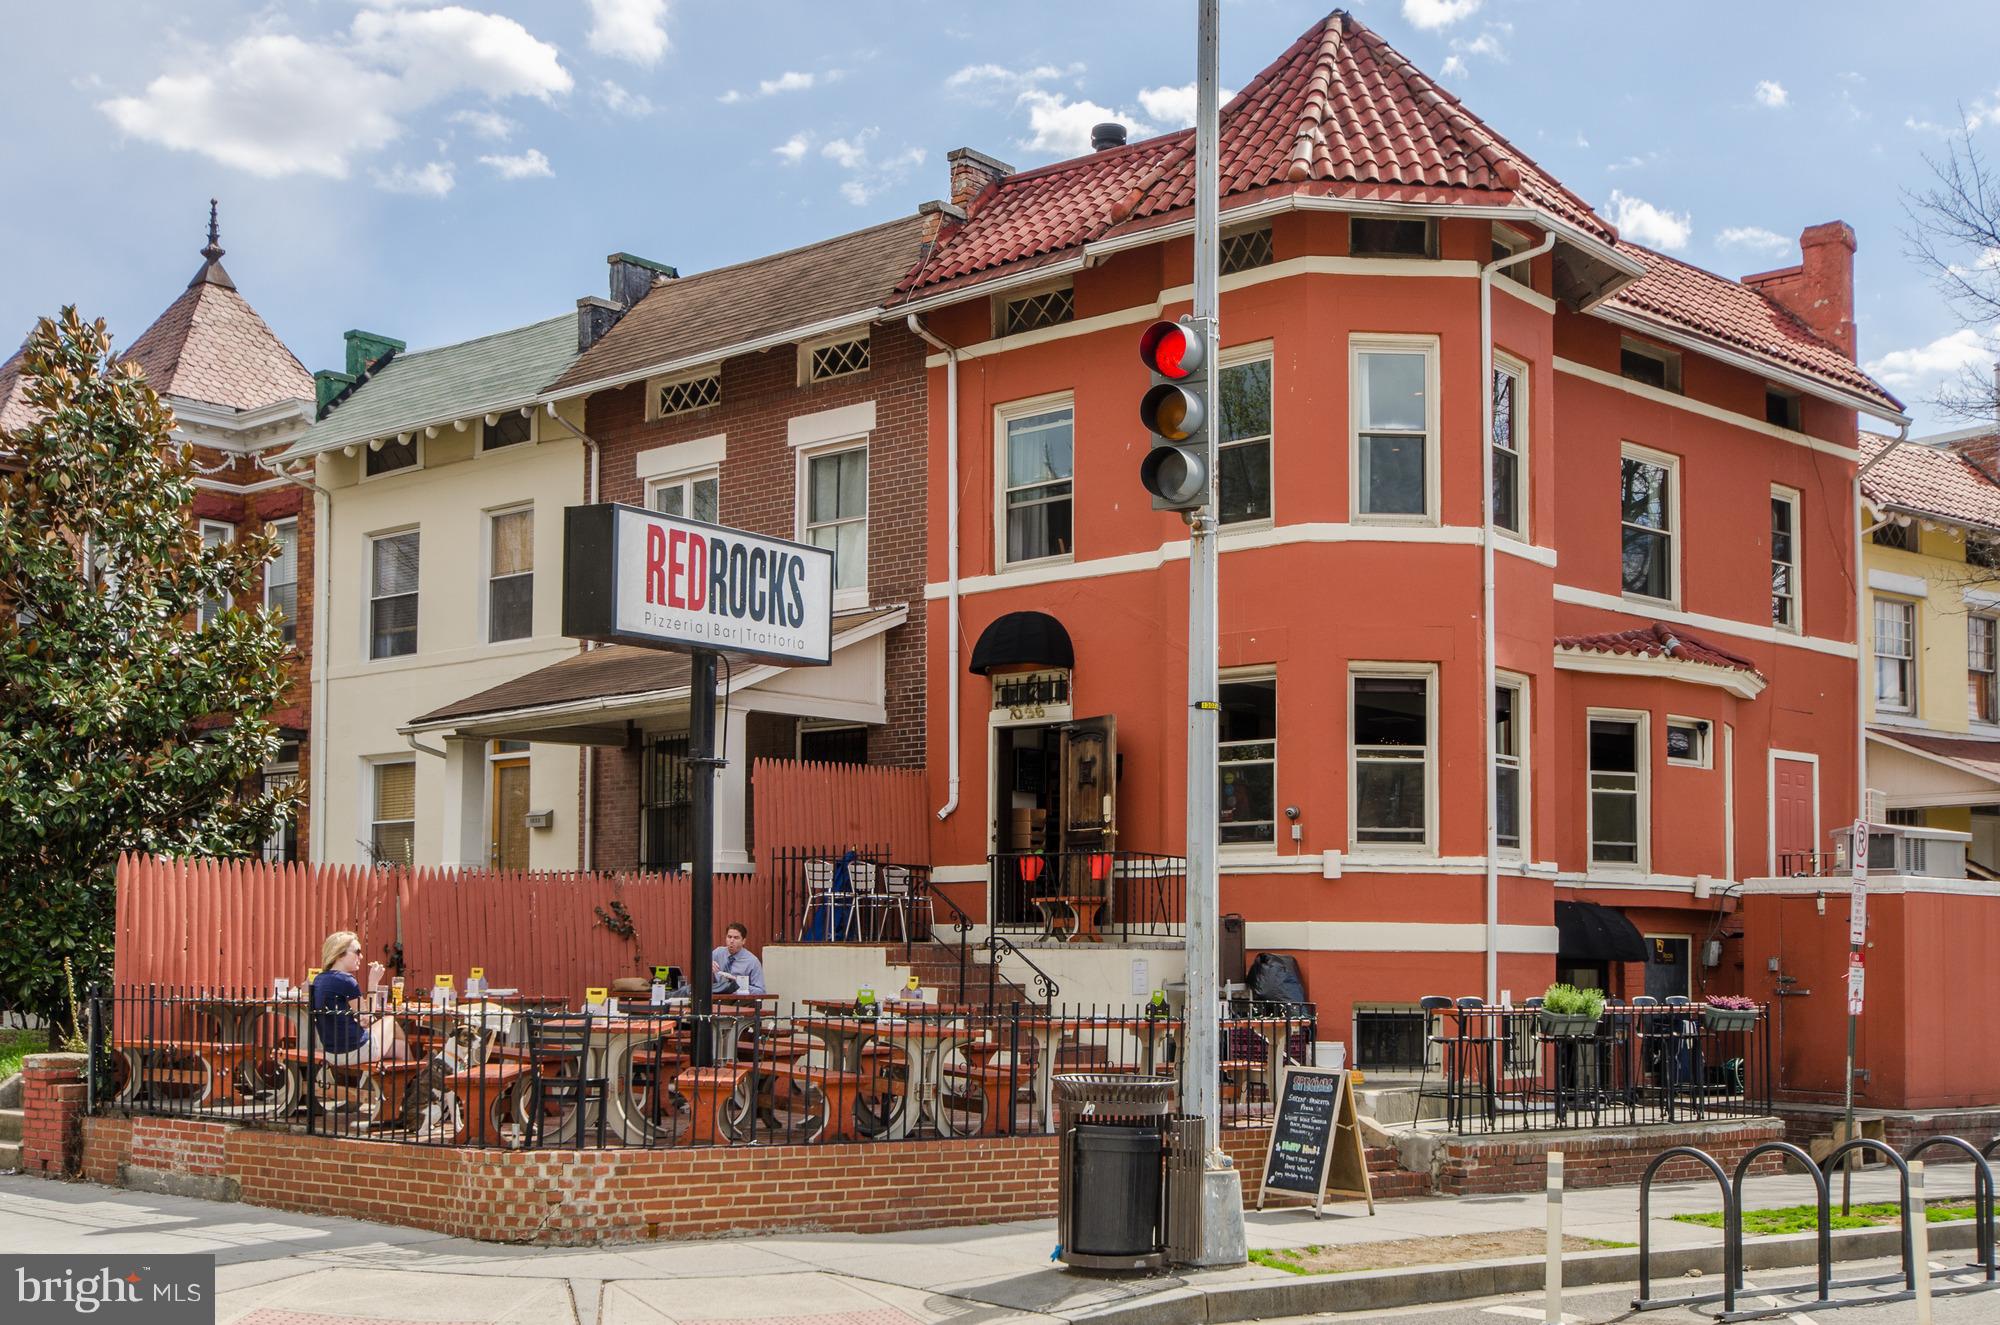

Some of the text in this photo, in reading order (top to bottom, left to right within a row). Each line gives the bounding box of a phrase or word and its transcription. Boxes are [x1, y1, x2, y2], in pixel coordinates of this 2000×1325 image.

[646, 523, 805, 629] REDROCKS
[644, 611, 805, 650] Pizzeria Bar Trattoria
